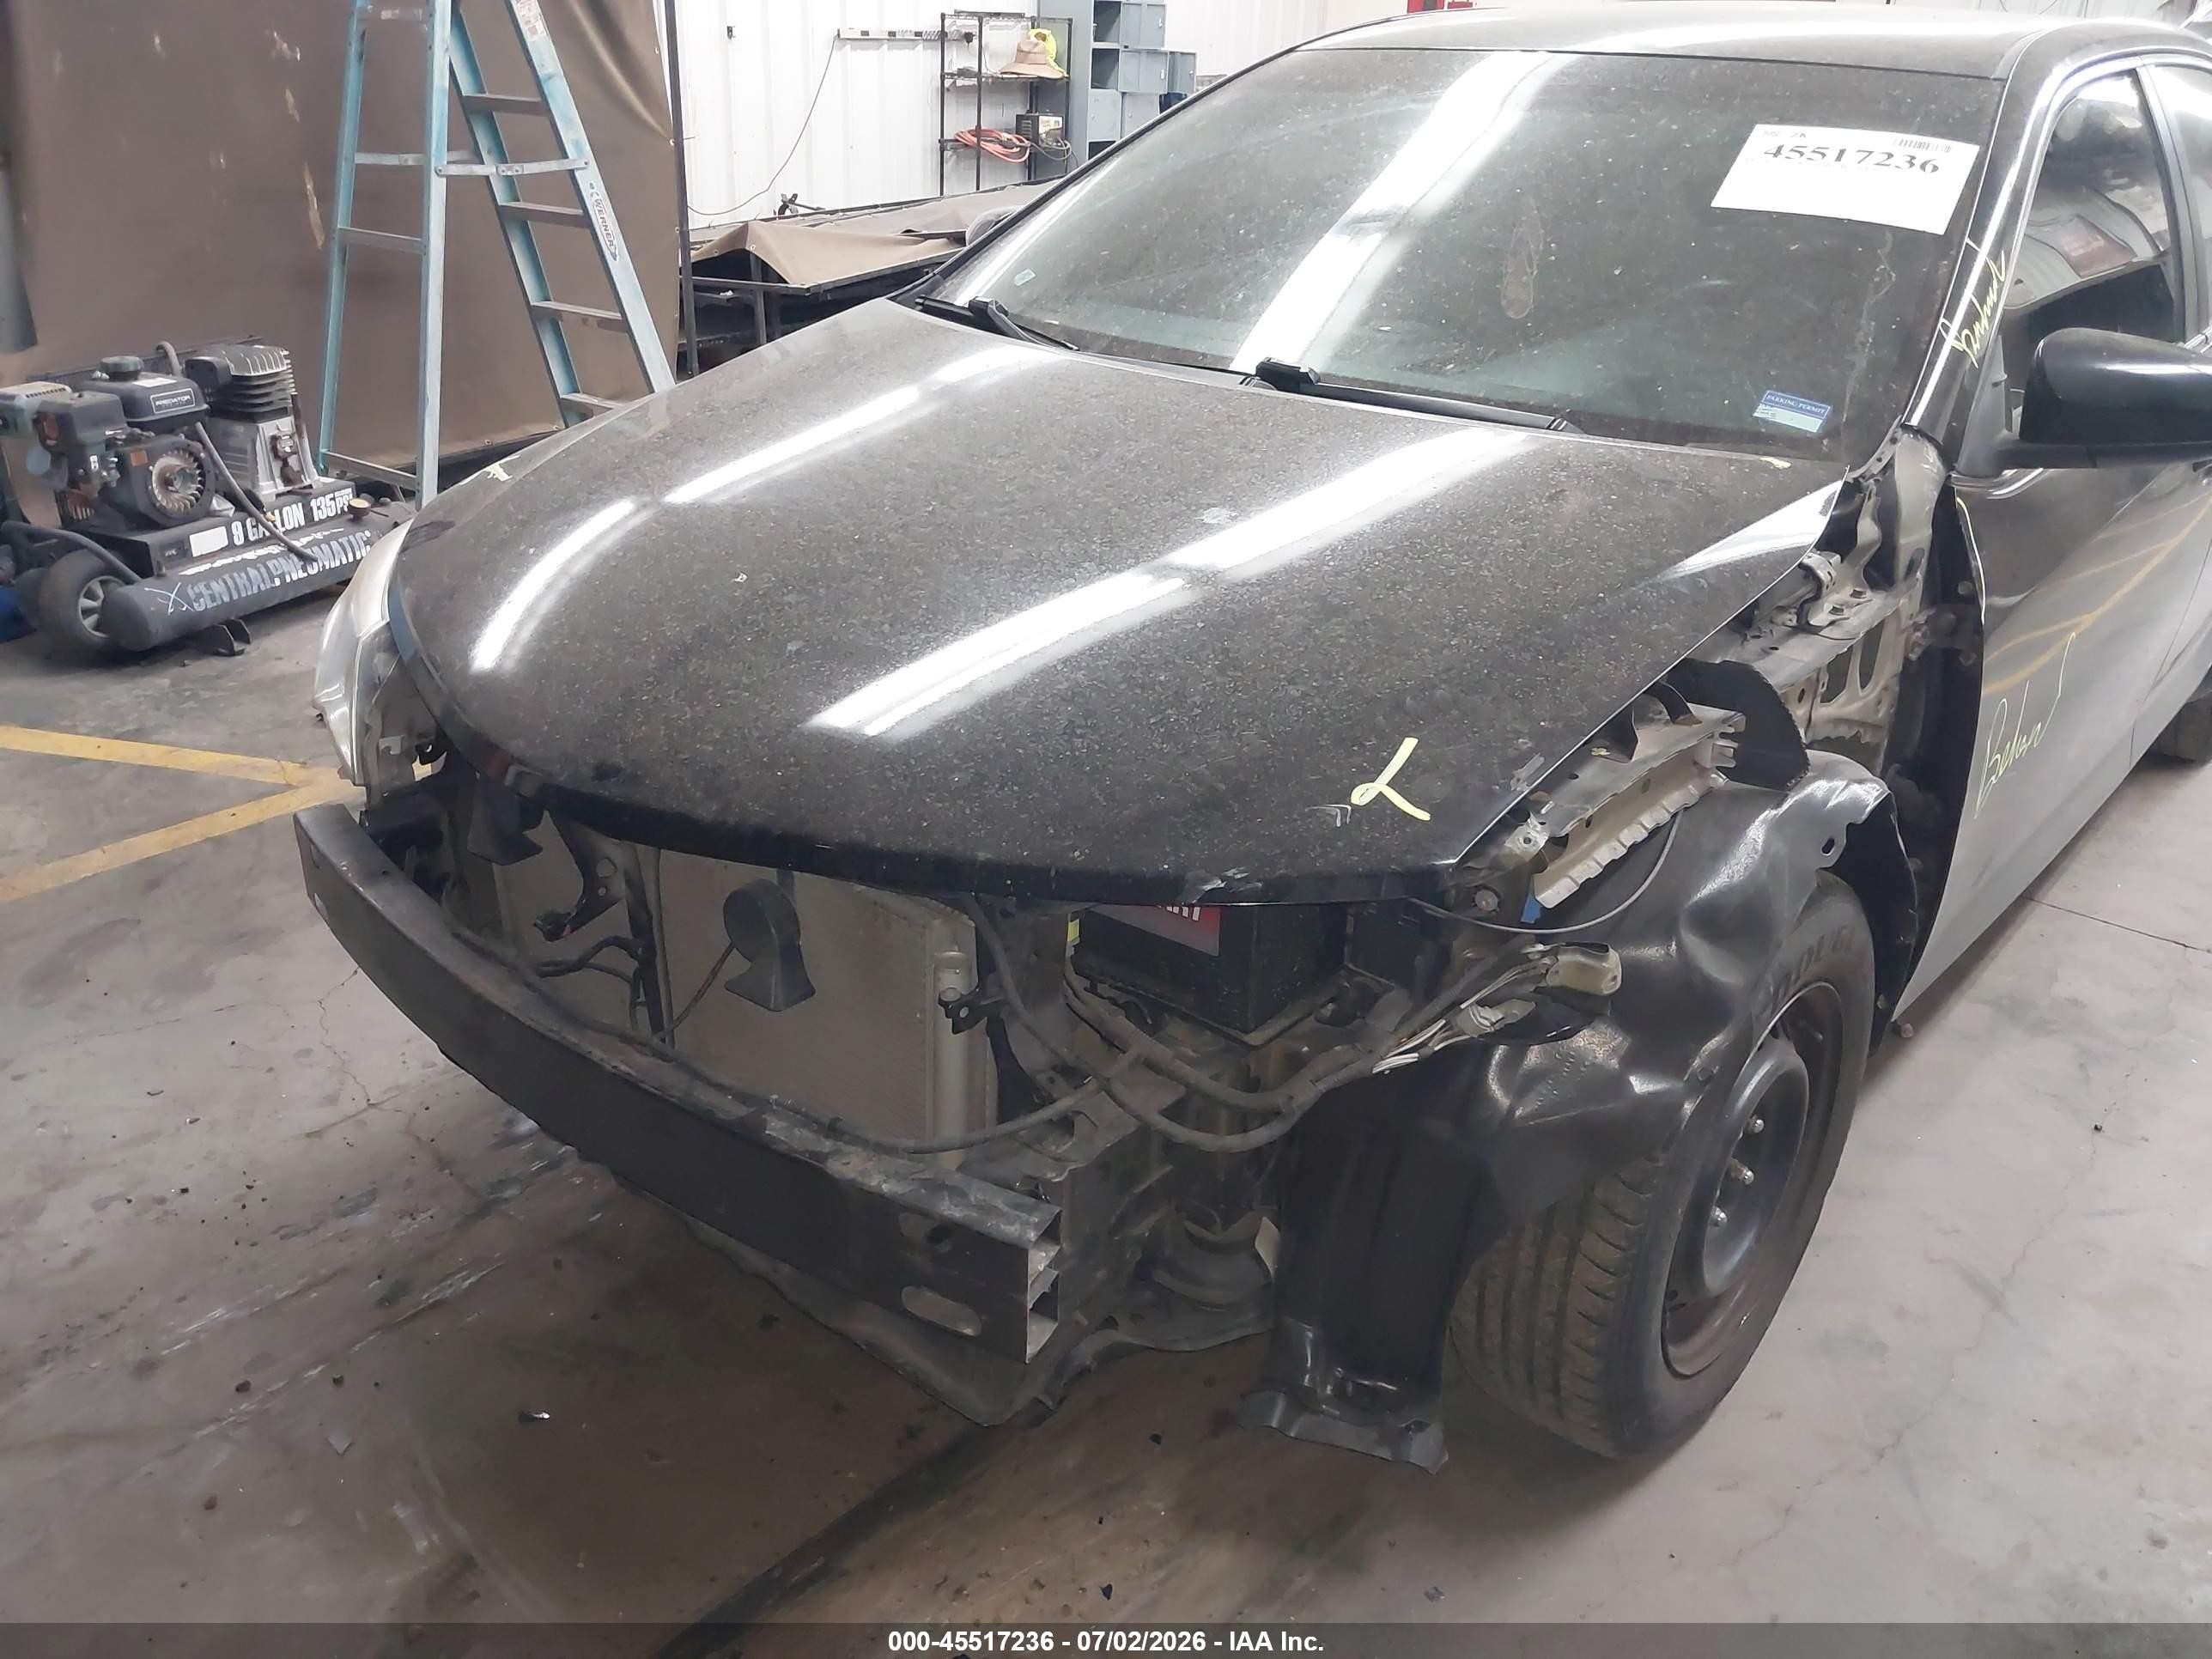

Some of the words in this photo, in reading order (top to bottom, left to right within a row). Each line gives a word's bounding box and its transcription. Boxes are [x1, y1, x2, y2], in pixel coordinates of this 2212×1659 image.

[1763, 143, 1941, 174] 45517236
[594, 198, 615, 247] WERNER
[1765, 395, 1797, 407] PARKING
[1798, 403, 1826, 414] PERMIT
[246, 502, 306, 542] GALON
[310, 493, 337, 522] 135
